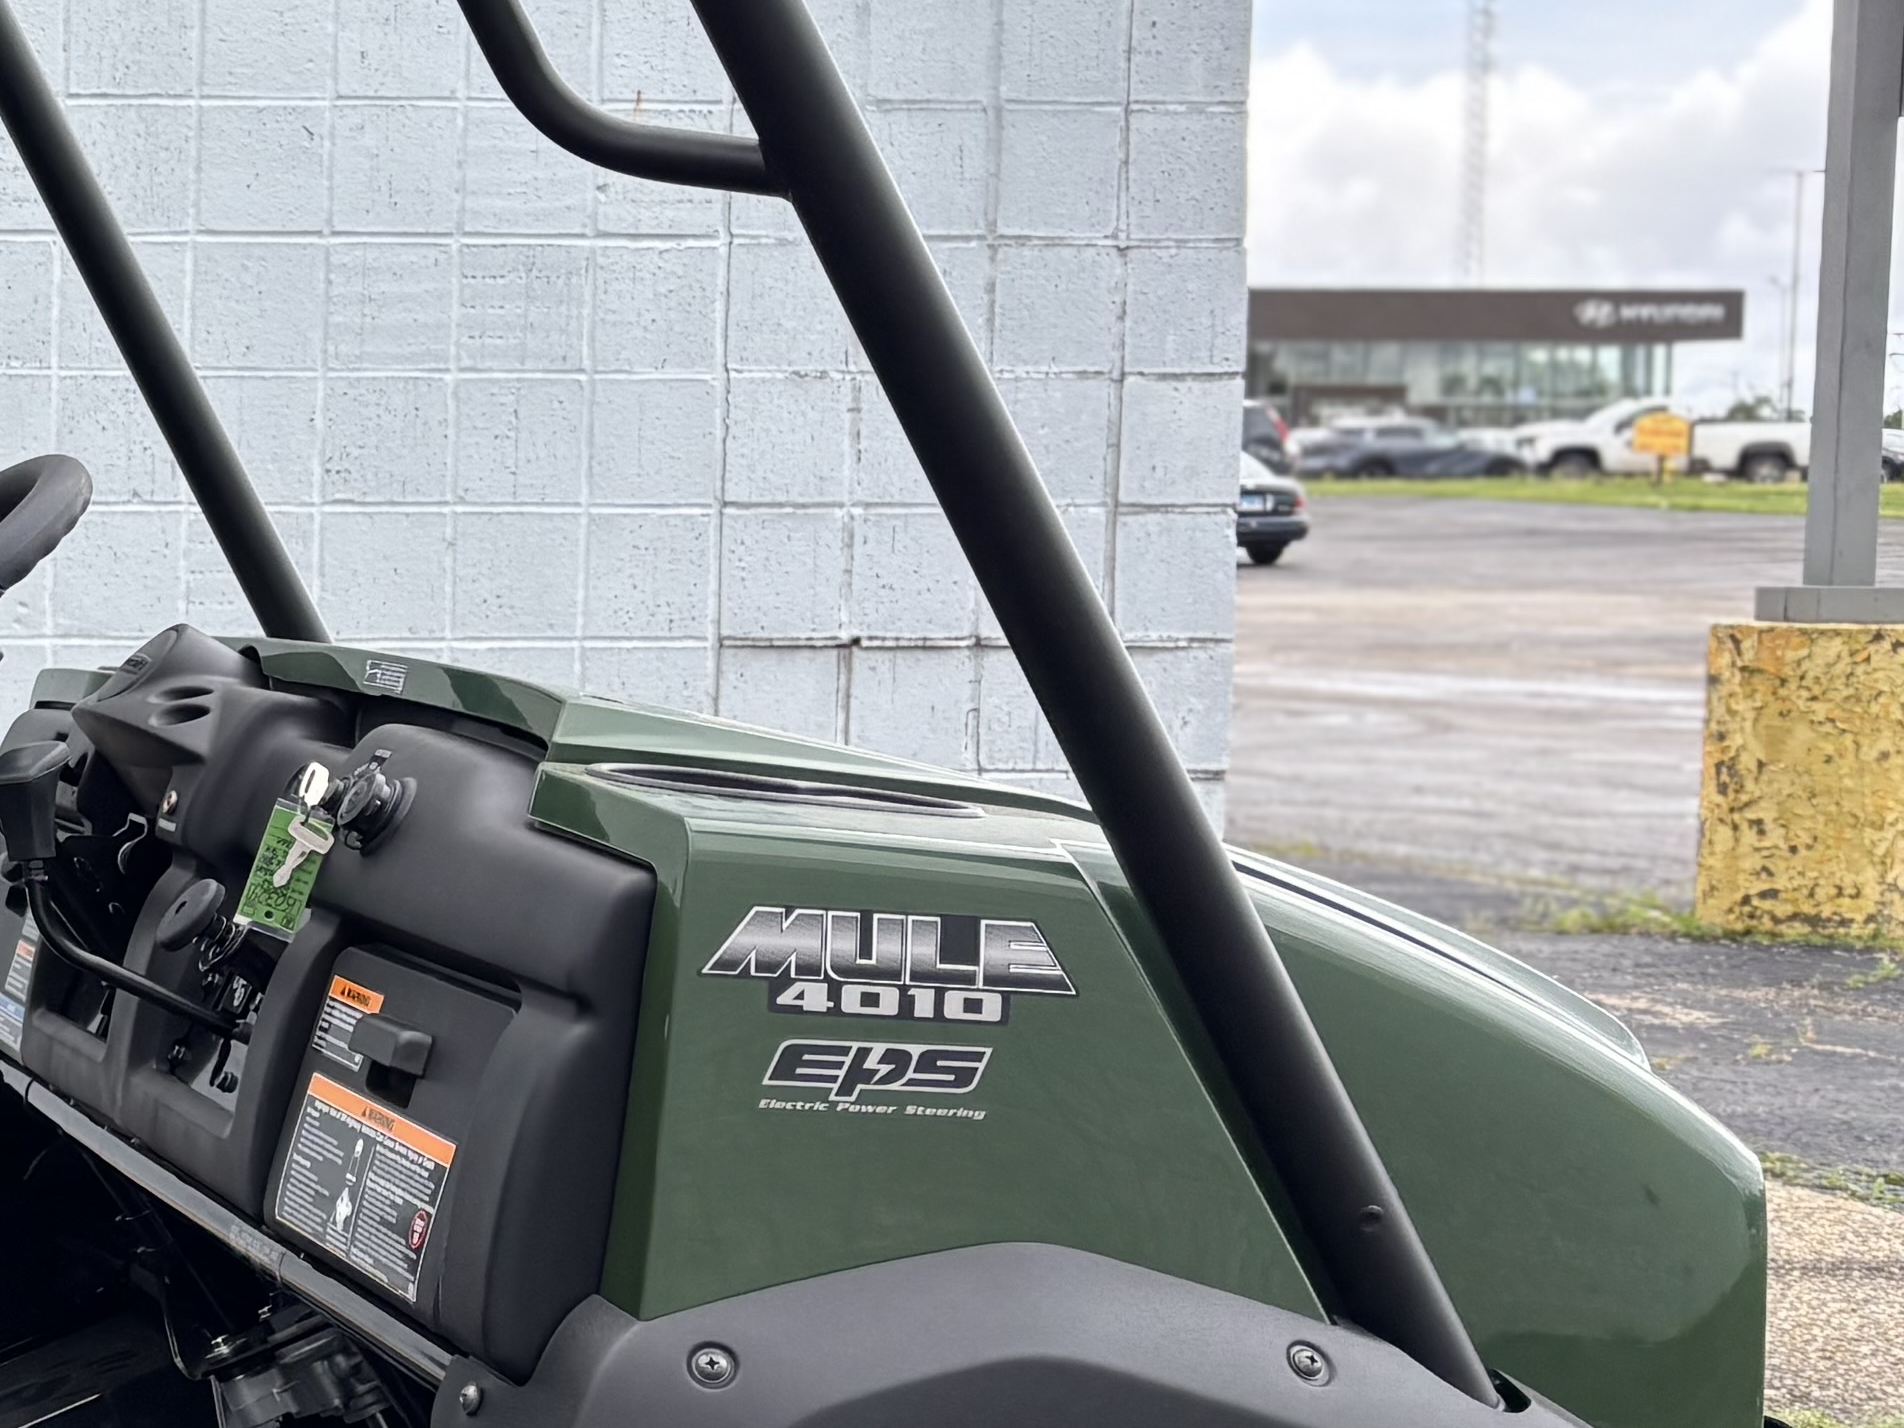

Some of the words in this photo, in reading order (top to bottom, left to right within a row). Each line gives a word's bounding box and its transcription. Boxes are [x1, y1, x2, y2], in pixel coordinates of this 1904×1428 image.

[701, 905, 1078, 996] MULE
[776, 983, 1003, 1022] 4010
[762, 1039, 993, 1102] EPS
[758, 1098, 828, 1112] Electric
[836, 1102, 897, 1115] Power
[904, 1105, 987, 1120] Steering
